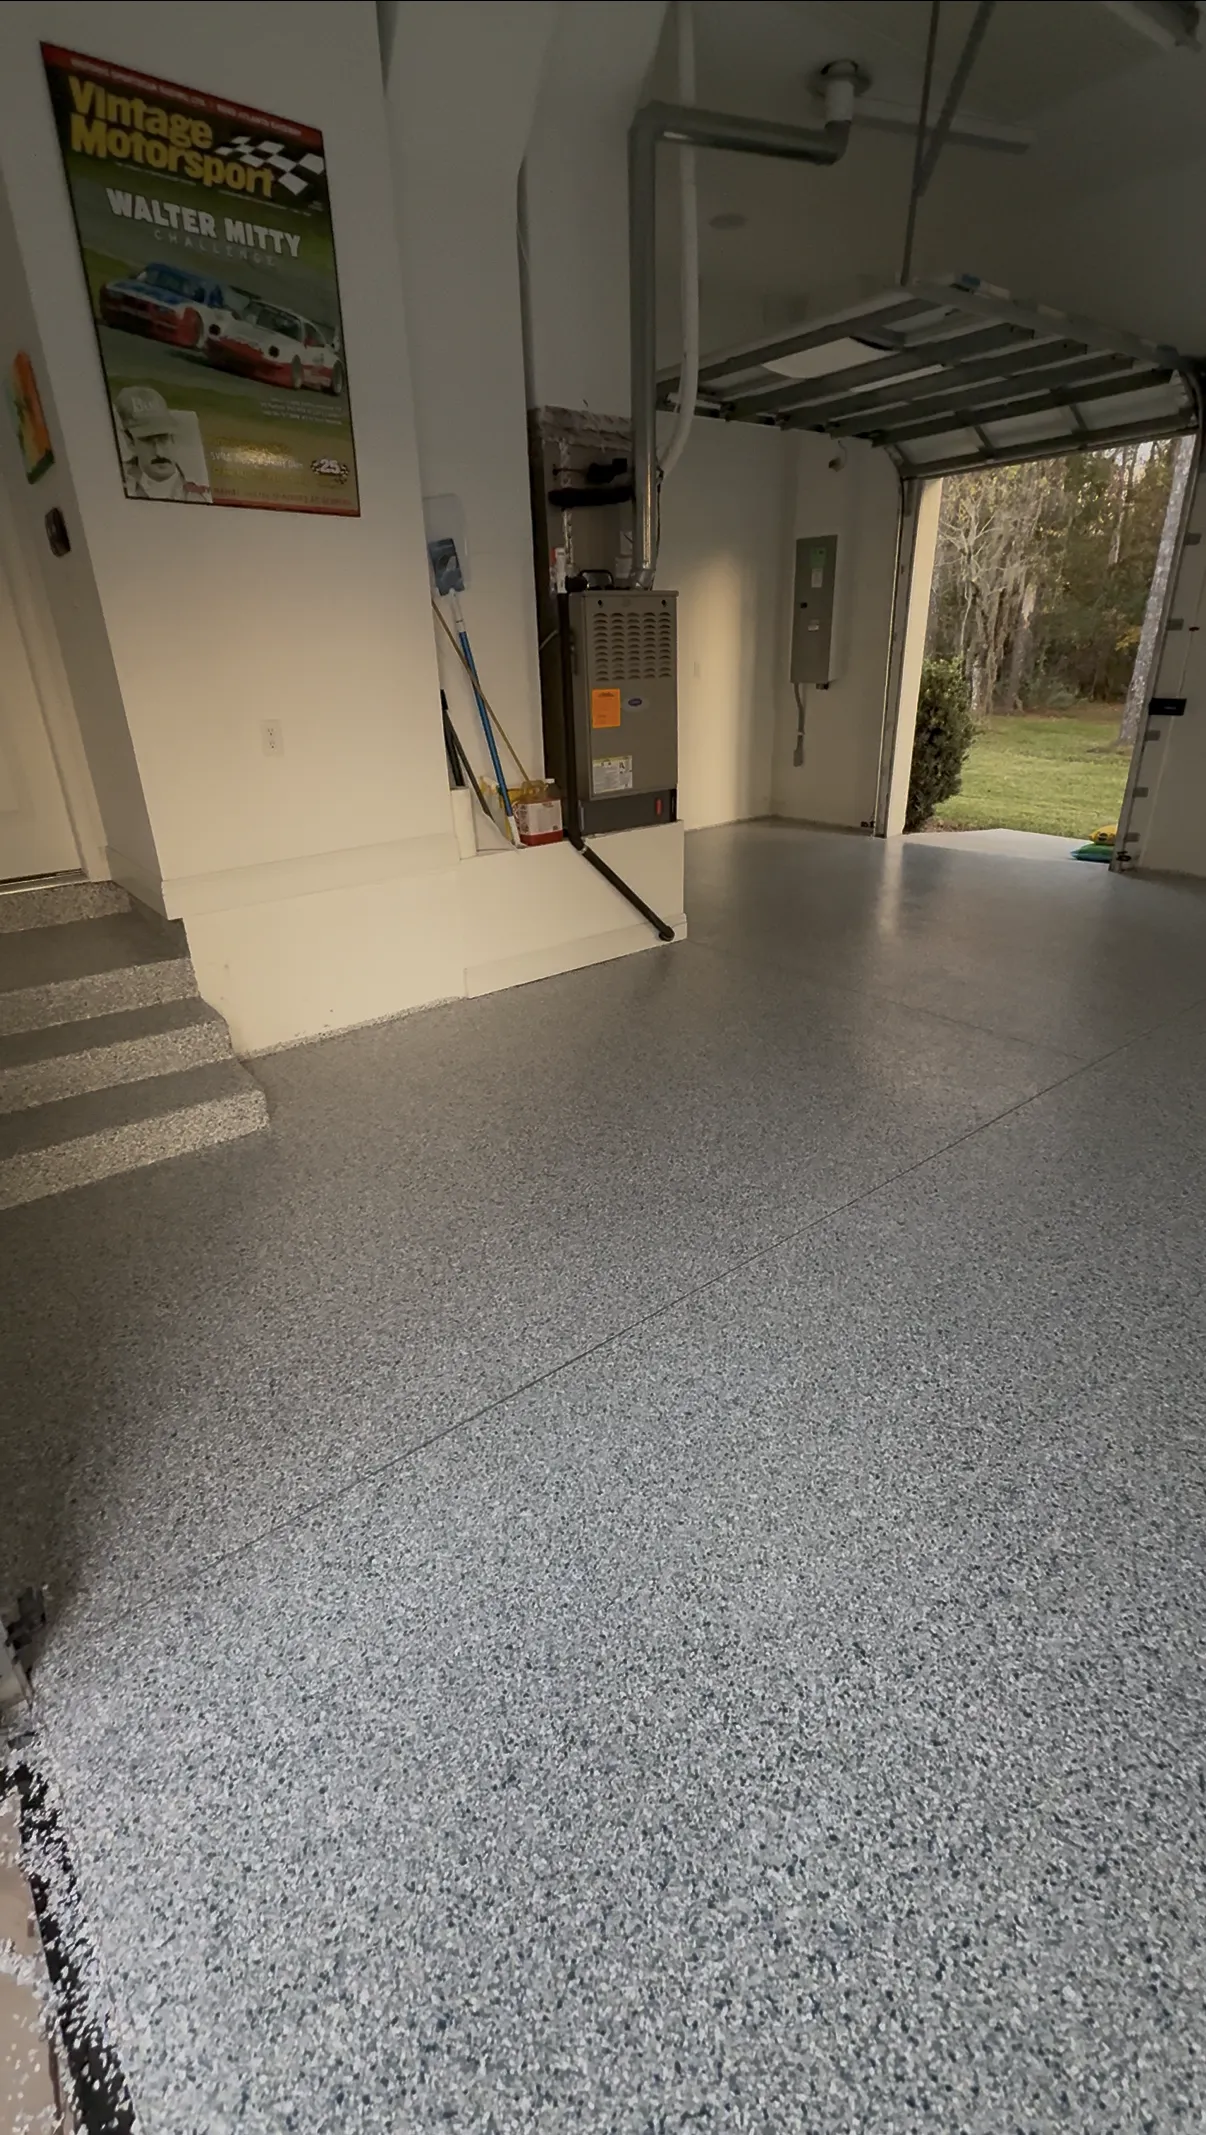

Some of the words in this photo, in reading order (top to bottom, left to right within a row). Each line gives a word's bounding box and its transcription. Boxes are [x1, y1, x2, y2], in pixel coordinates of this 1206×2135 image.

[69, 112, 275, 197] Motorsport
[106, 187, 217, 239] WALTER
[224, 217, 301, 257] MITTY
[154, 229, 278, 266] CHALLENGE
[320, 458, 341, 474] 25
